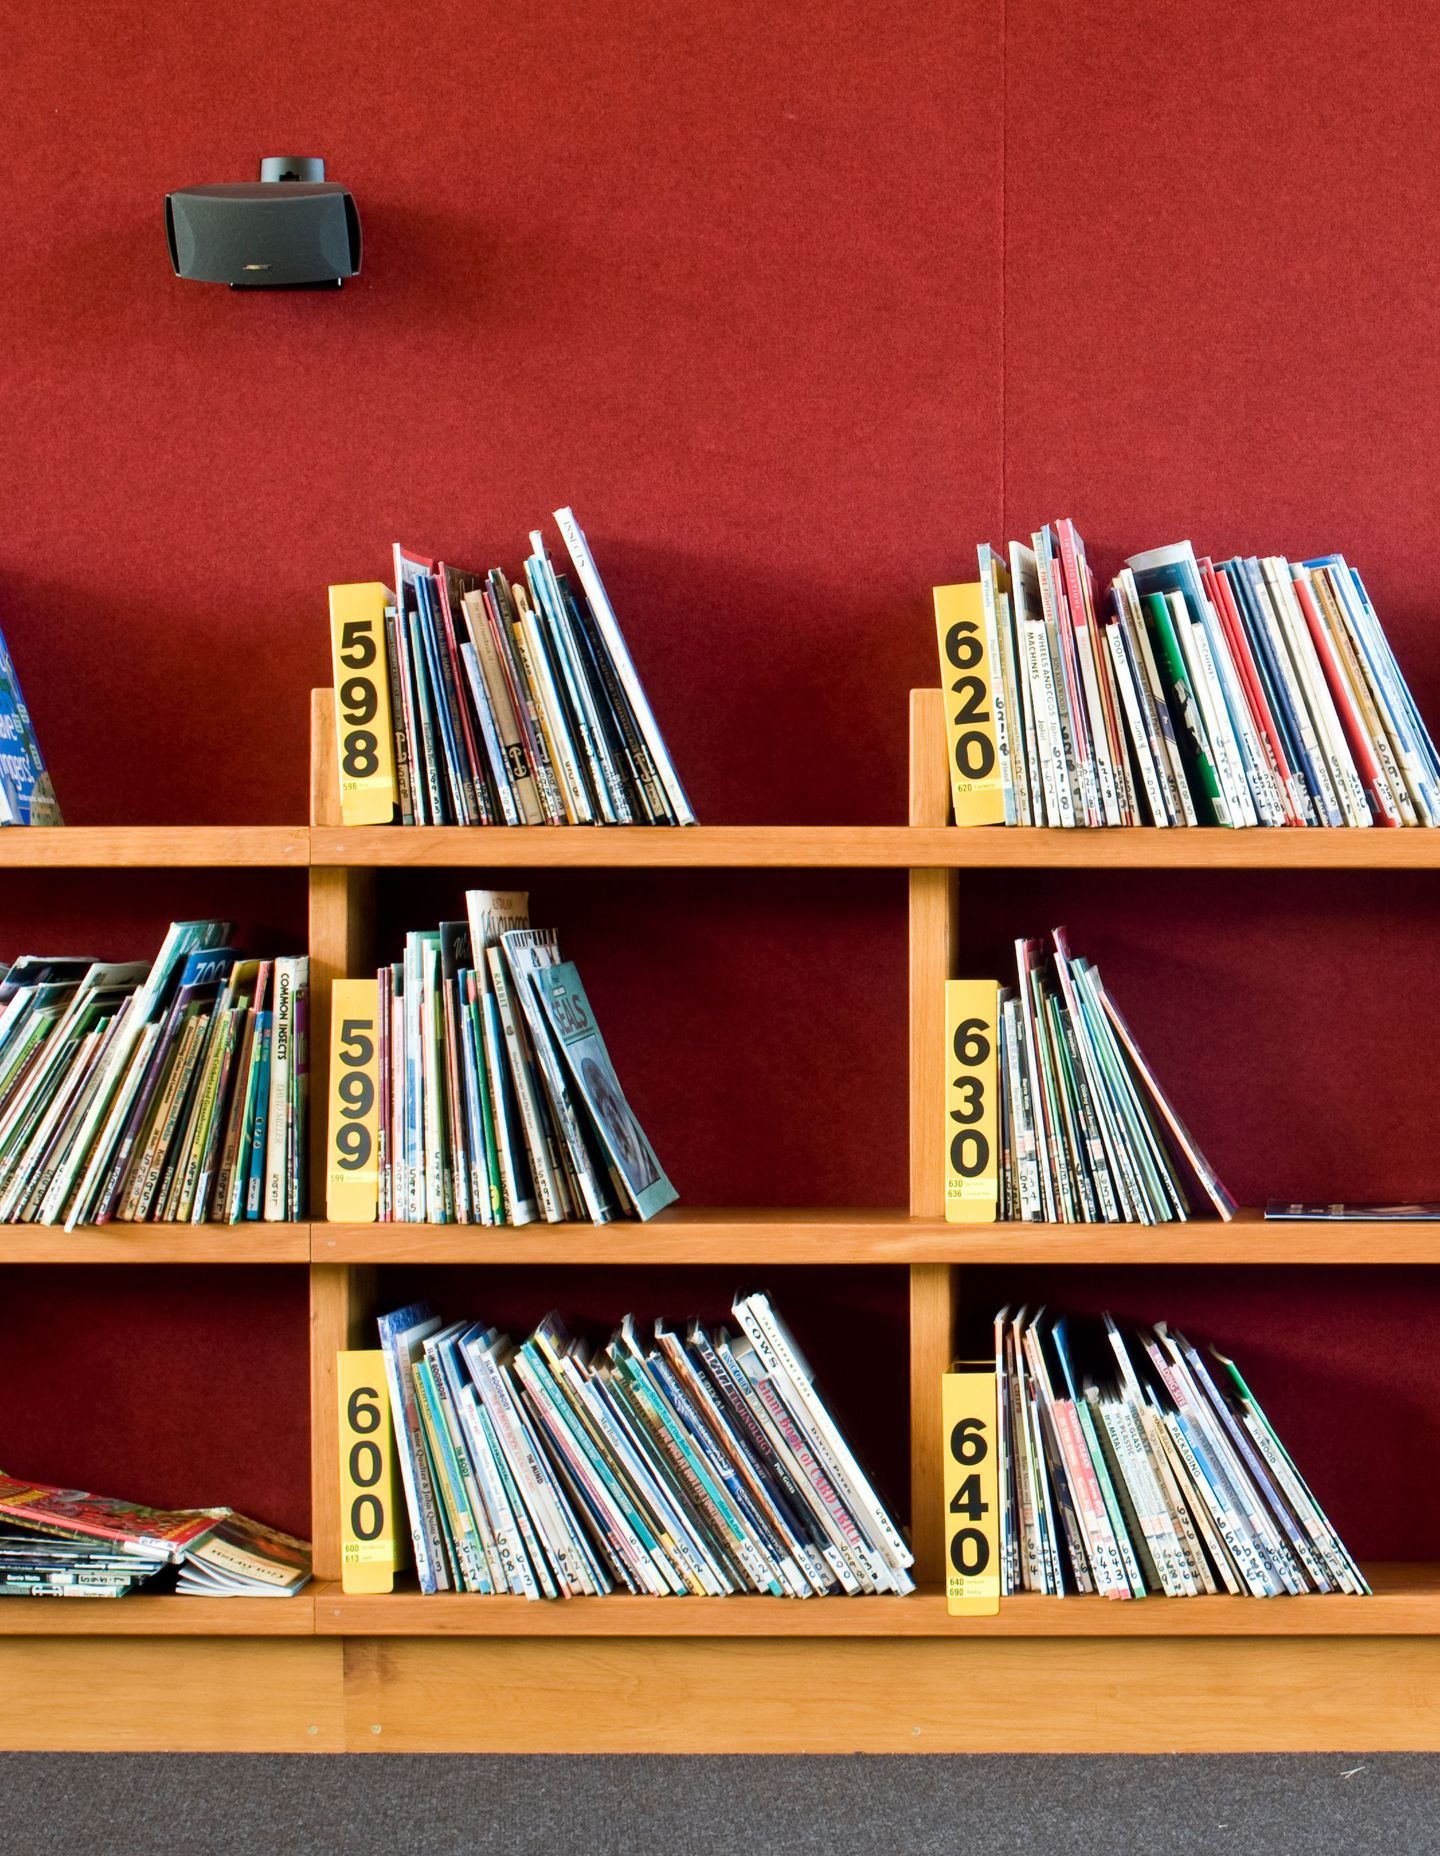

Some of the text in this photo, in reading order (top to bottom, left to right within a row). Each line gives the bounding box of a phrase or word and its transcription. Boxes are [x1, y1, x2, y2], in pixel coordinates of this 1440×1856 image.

[562, 519, 587, 568] INSECTS
[1025, 631, 1040, 680] MACHINES
[1037, 632, 1049, 667] WHEELS
[340, 621, 379, 778] 598
[945, 621, 996, 779] 620
[277, 972, 289, 1059] COMMON INSECTS
[491, 970, 509, 1008] RABBIT
[552, 995, 588, 1034] SEALS
[336, 1019, 374, 1170] 599
[950, 1018, 990, 1178] 630
[948, 1180, 963, 1188] 630
[743, 1312, 779, 1370] COWS
[760, 1316, 797, 1373] THE ELEPHANT
[1152, 1351, 1186, 1407] BUILDING SITE
[430, 1362, 448, 1401] GOODBODY
[457, 1456, 470, 1478] BODY
[483, 1359, 543, 1484] SLIM GOODBODY MIND
[727, 1388, 774, 1457] TECHNOLOGY
[756, 1378, 837, 1505] Giant Book of CARD
[1107, 1426, 1122, 1451] METAL
[1126, 1399, 1153, 1456] CHOCOLATE
[1129, 1426, 1142, 1453] GLASS
[348, 1387, 384, 1541] 600
[1170, 1425, 1201, 1478] PACKAGING
[1258, 1439, 1276, 1464] WOOD
[950, 1418, 990, 1576] 640
